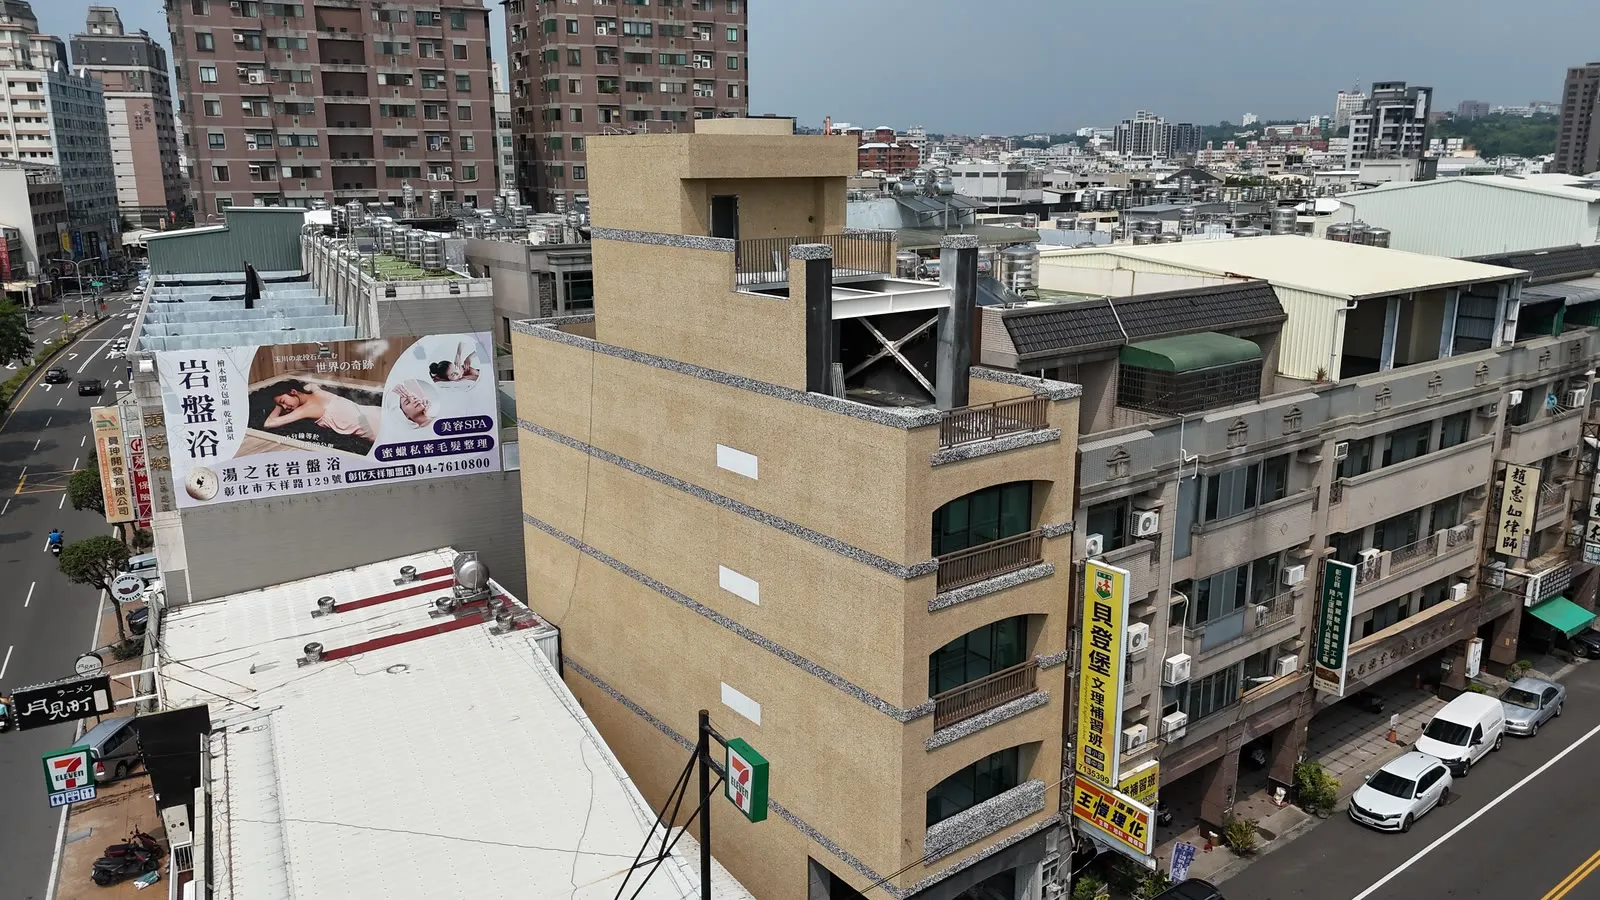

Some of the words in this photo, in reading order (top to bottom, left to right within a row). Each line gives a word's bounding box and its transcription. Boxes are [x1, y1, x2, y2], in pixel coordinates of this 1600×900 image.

[316, 359, 375, 373] 世界の奇跡
[177, 359, 220, 459] 岩盤浴
[223, 410, 235, 441] 乾式溫泉
[441, 419, 487, 432] 美容SPA
[381, 438, 488, 459] 蜜蠟私密毛髮整理
[222, 457, 340, 483] 湯之花岩盤浴
[348, 465, 414, 482] 彰化天祥加盟店
[417, 458, 490, 474] 04-7610800
[224, 474, 342, 497] 彰化市天祥路129號
[1502, 467, 1528, 554] 趙惠如律師
[1088, 601, 1113, 678] 貝登堡
[57, 684, 93, 696] ラーメン
[22, 696, 92, 721] 月見町
[1088, 676, 1106, 749] 文理補習班
[1078, 763, 1109, 784] 7135399
